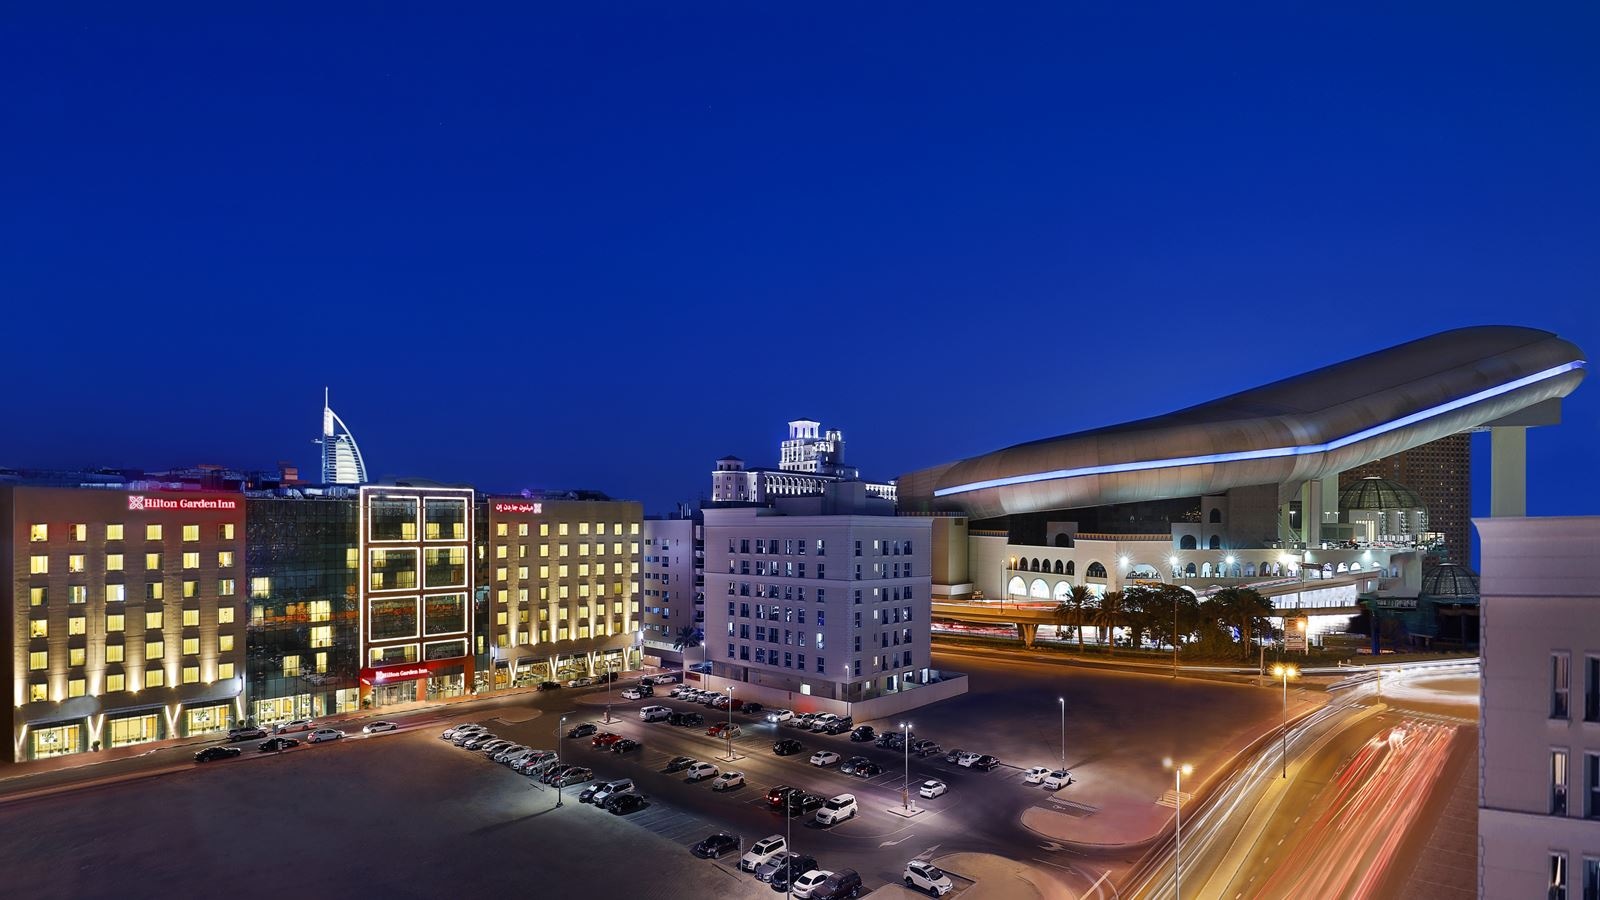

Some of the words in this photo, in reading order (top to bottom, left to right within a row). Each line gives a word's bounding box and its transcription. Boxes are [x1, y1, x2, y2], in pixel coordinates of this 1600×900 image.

[144, 498, 177, 508] Hilton
[179, 499, 217, 509] Garden
[217, 499, 236, 509] Inn
